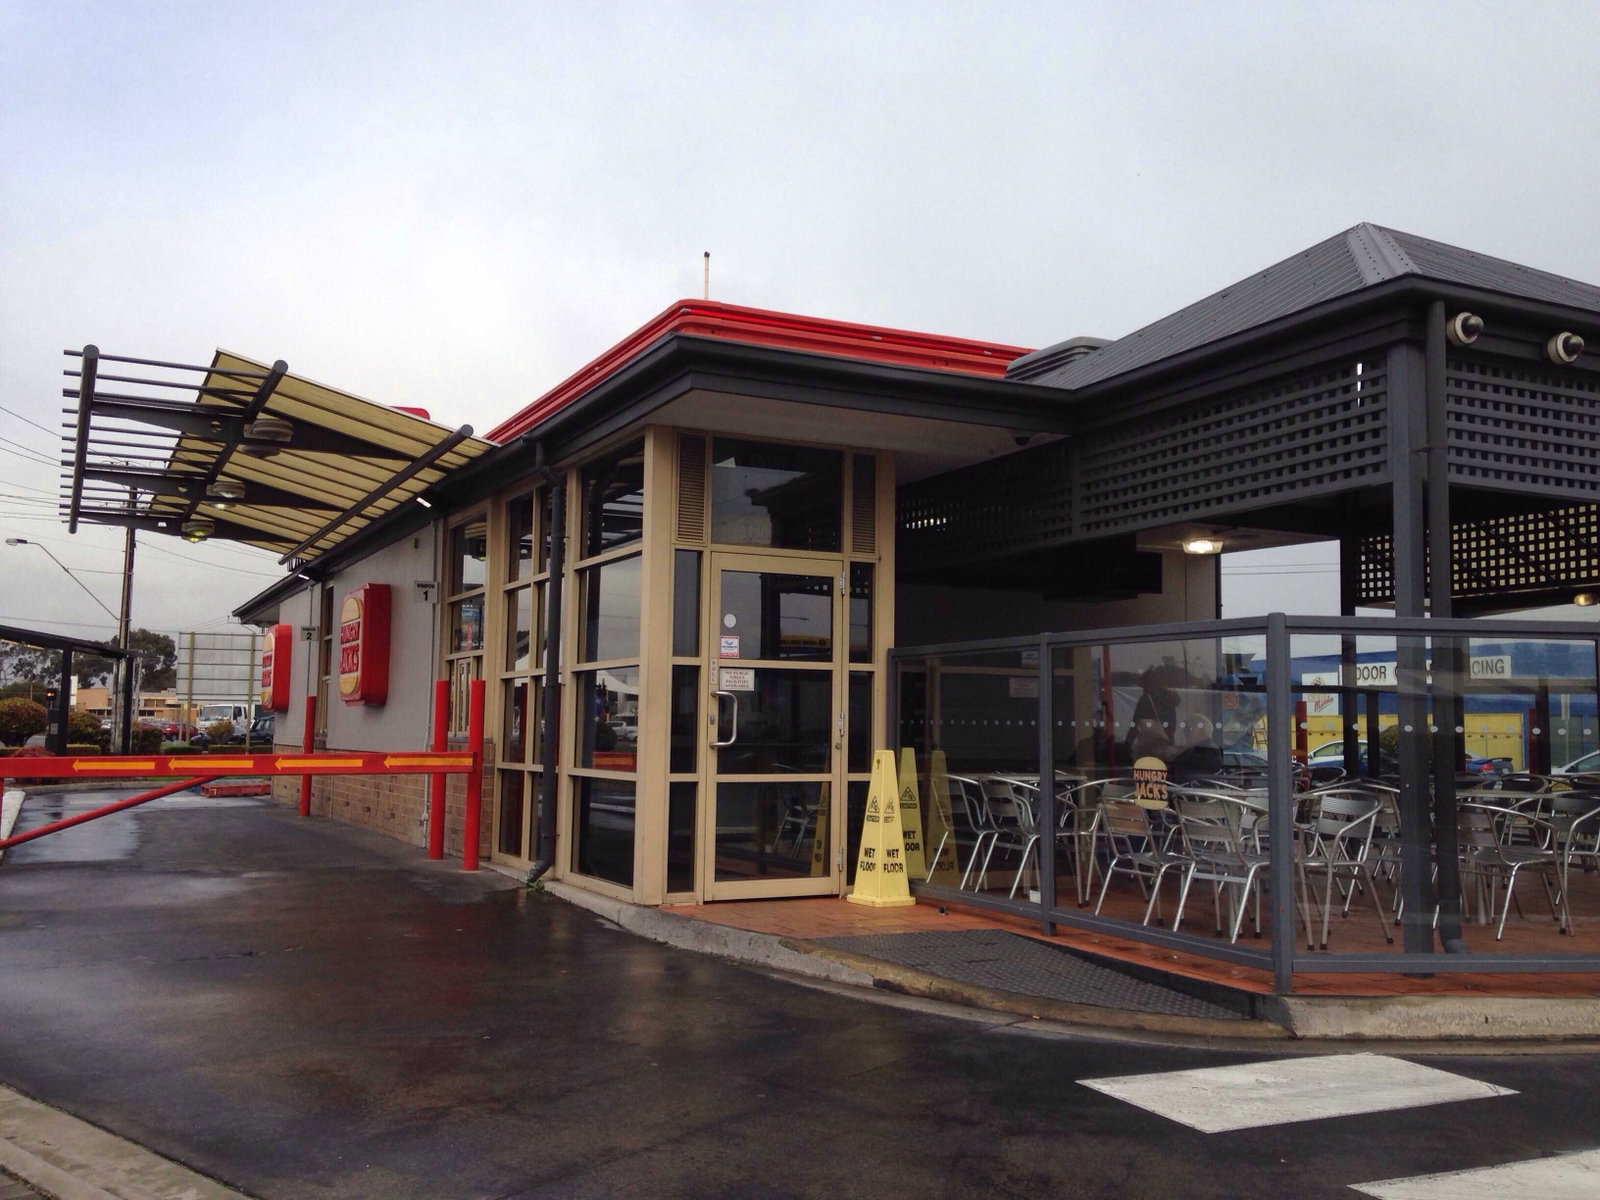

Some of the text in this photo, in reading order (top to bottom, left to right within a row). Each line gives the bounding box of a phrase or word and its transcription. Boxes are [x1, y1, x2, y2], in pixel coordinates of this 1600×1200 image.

[423, 590, 429, 601] 1
[306, 632, 312, 640] 2
[1134, 770, 1167, 782] HUNGRY
[905, 842, 920, 851] OOR
[864, 848, 875, 858] WET
[886, 849, 899, 858] WET
